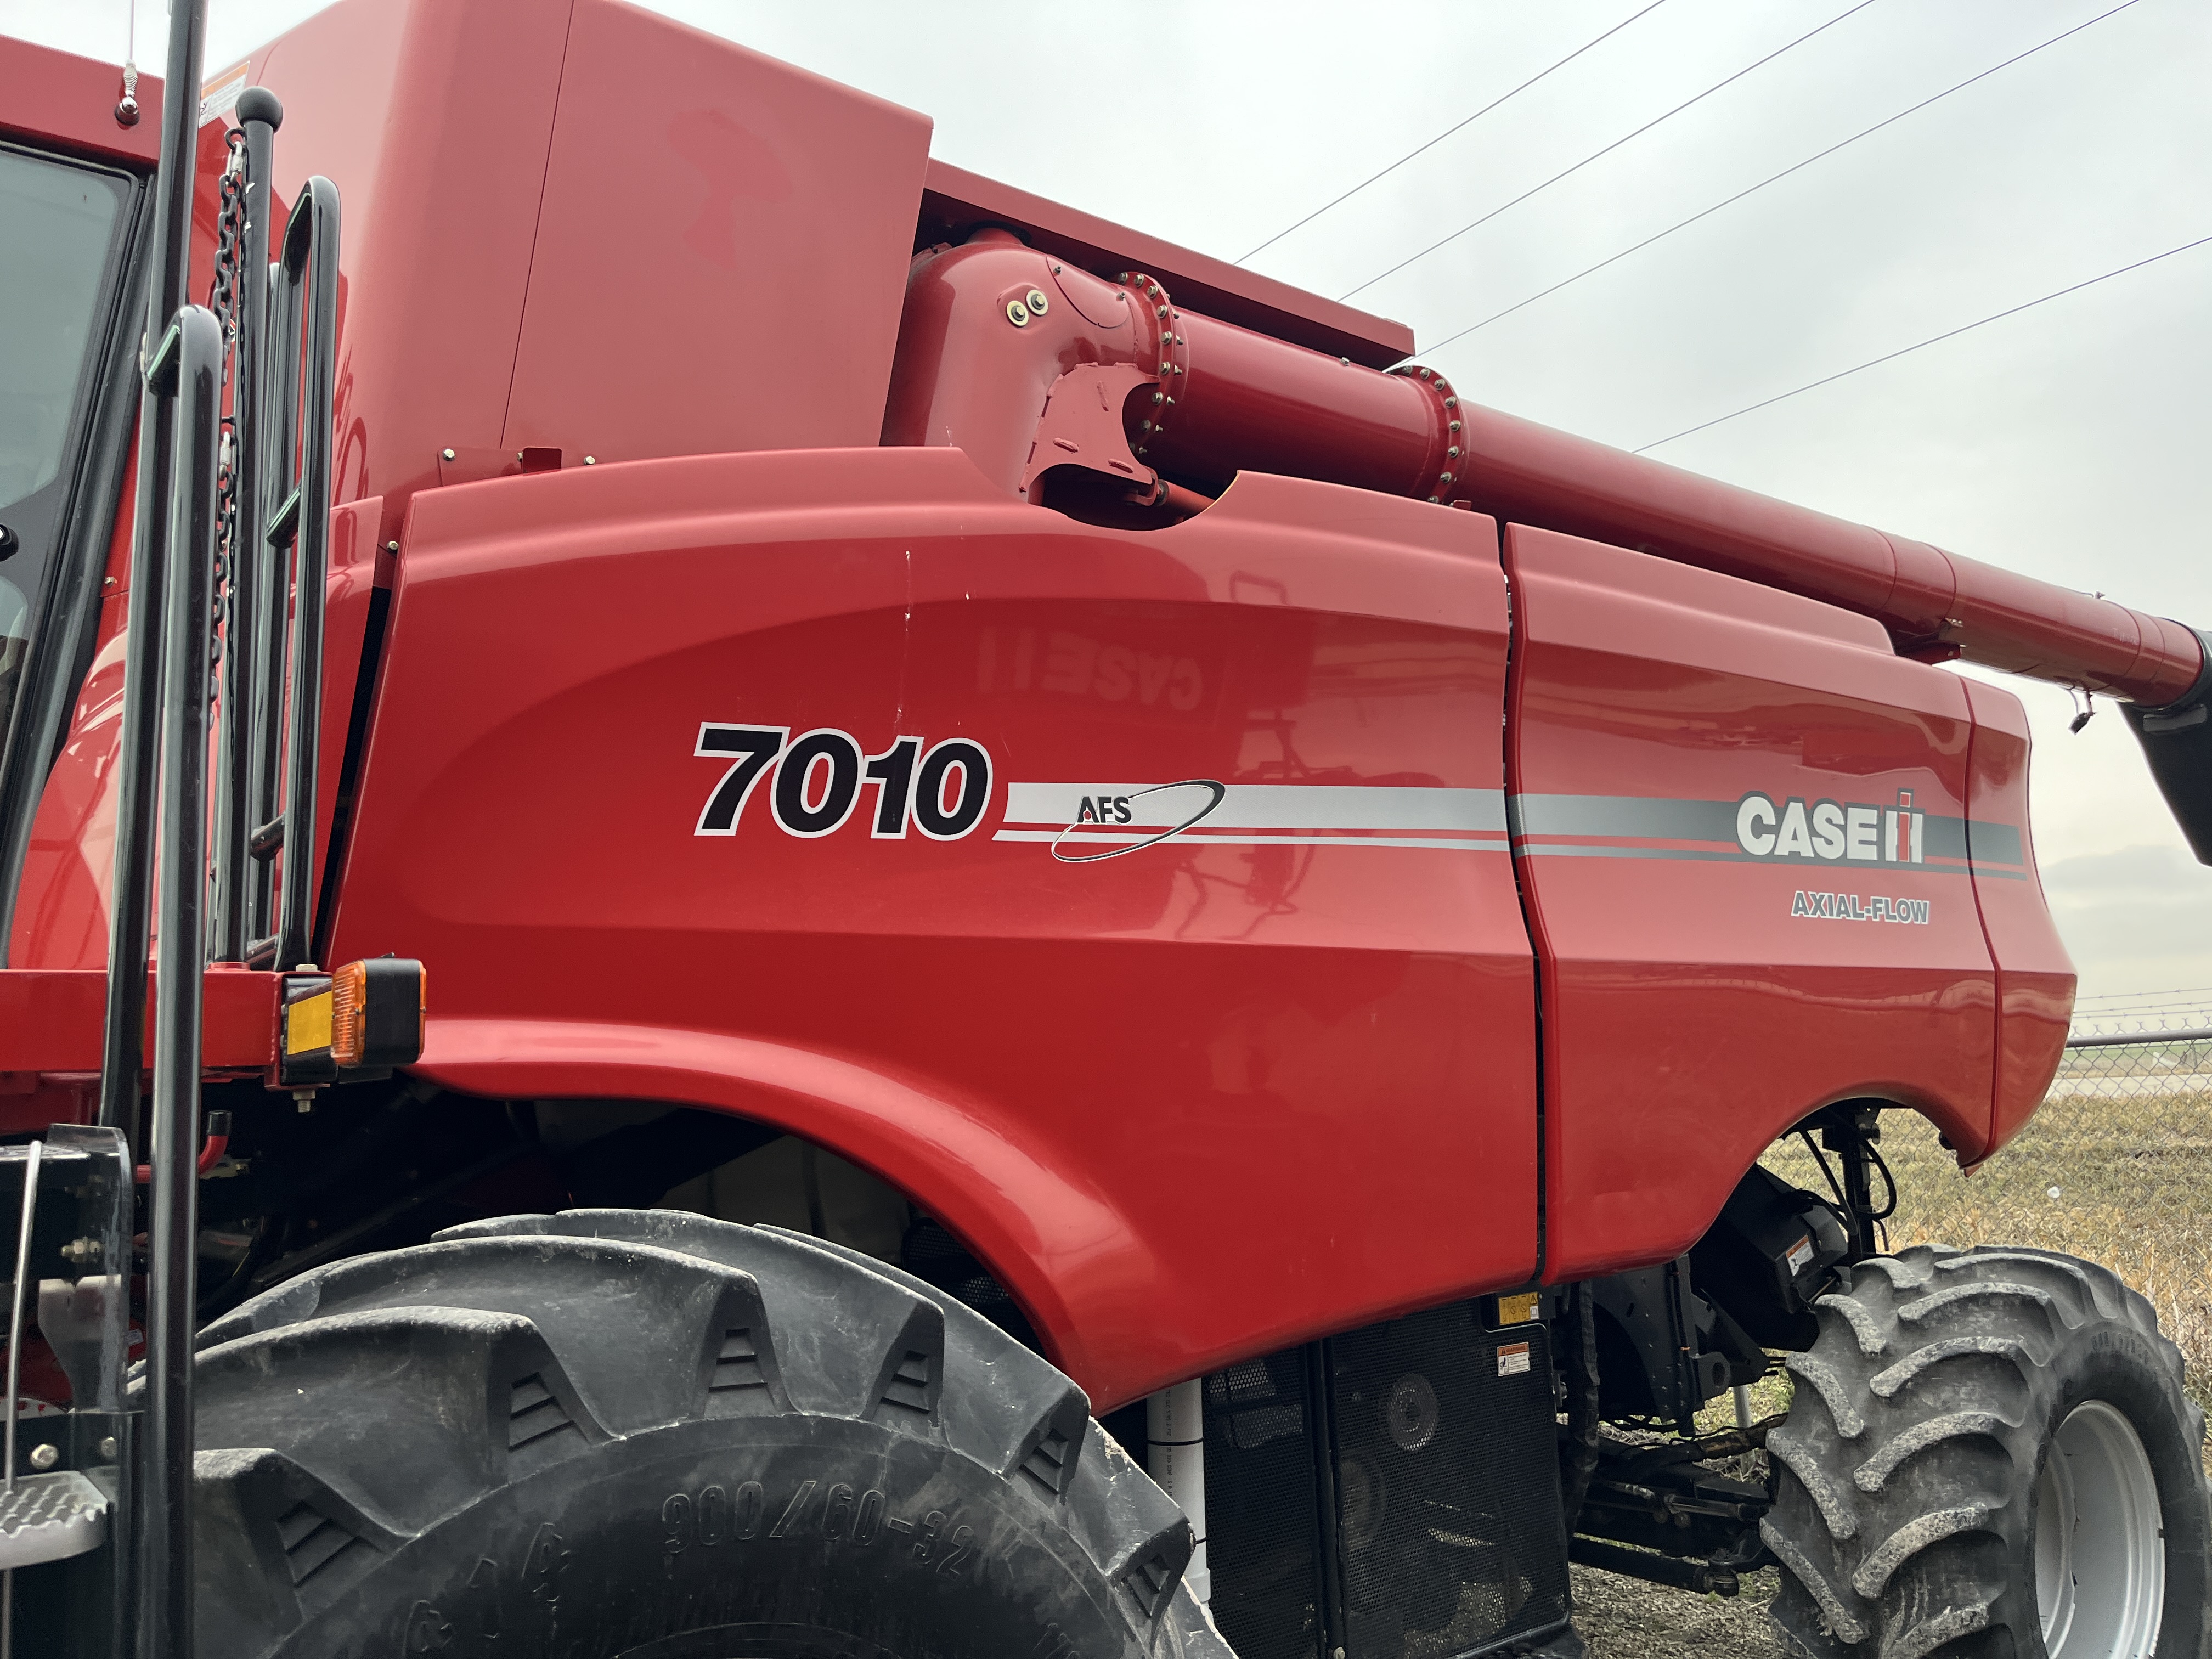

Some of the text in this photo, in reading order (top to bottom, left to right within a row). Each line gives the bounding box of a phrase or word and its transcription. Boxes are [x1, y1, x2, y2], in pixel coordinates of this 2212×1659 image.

[693, 721, 993, 841] 7010
[1077, 796, 1131, 823] AFS
[1791, 890, 1929, 924] AXIAL-FLOW
